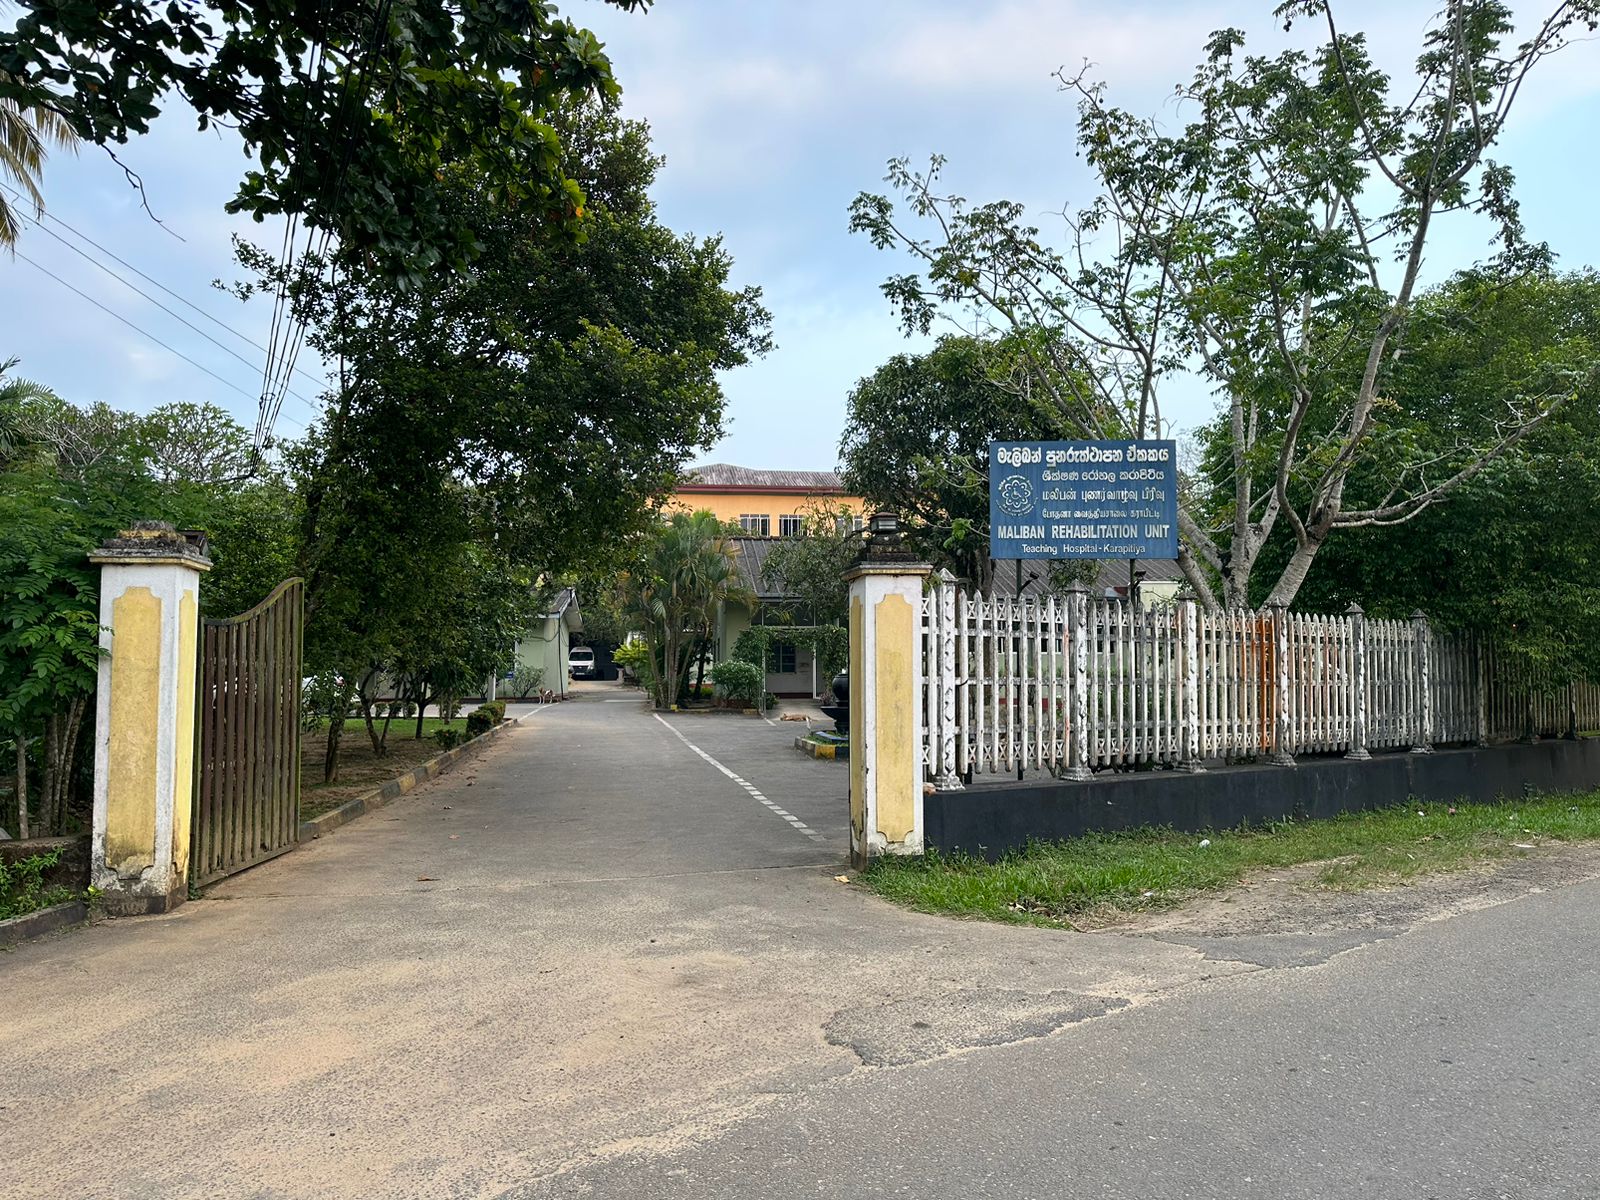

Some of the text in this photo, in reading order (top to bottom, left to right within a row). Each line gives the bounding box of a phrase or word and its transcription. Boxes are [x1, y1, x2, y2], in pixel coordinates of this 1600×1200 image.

[1081, 470, 1116, 483] රෝහල
[1141, 486, 1165, 502] பிரிவு
[998, 524, 1170, 538] MALIBAN REHABILITATION UNIT
[1022, 544, 1058, 556] Teaching
